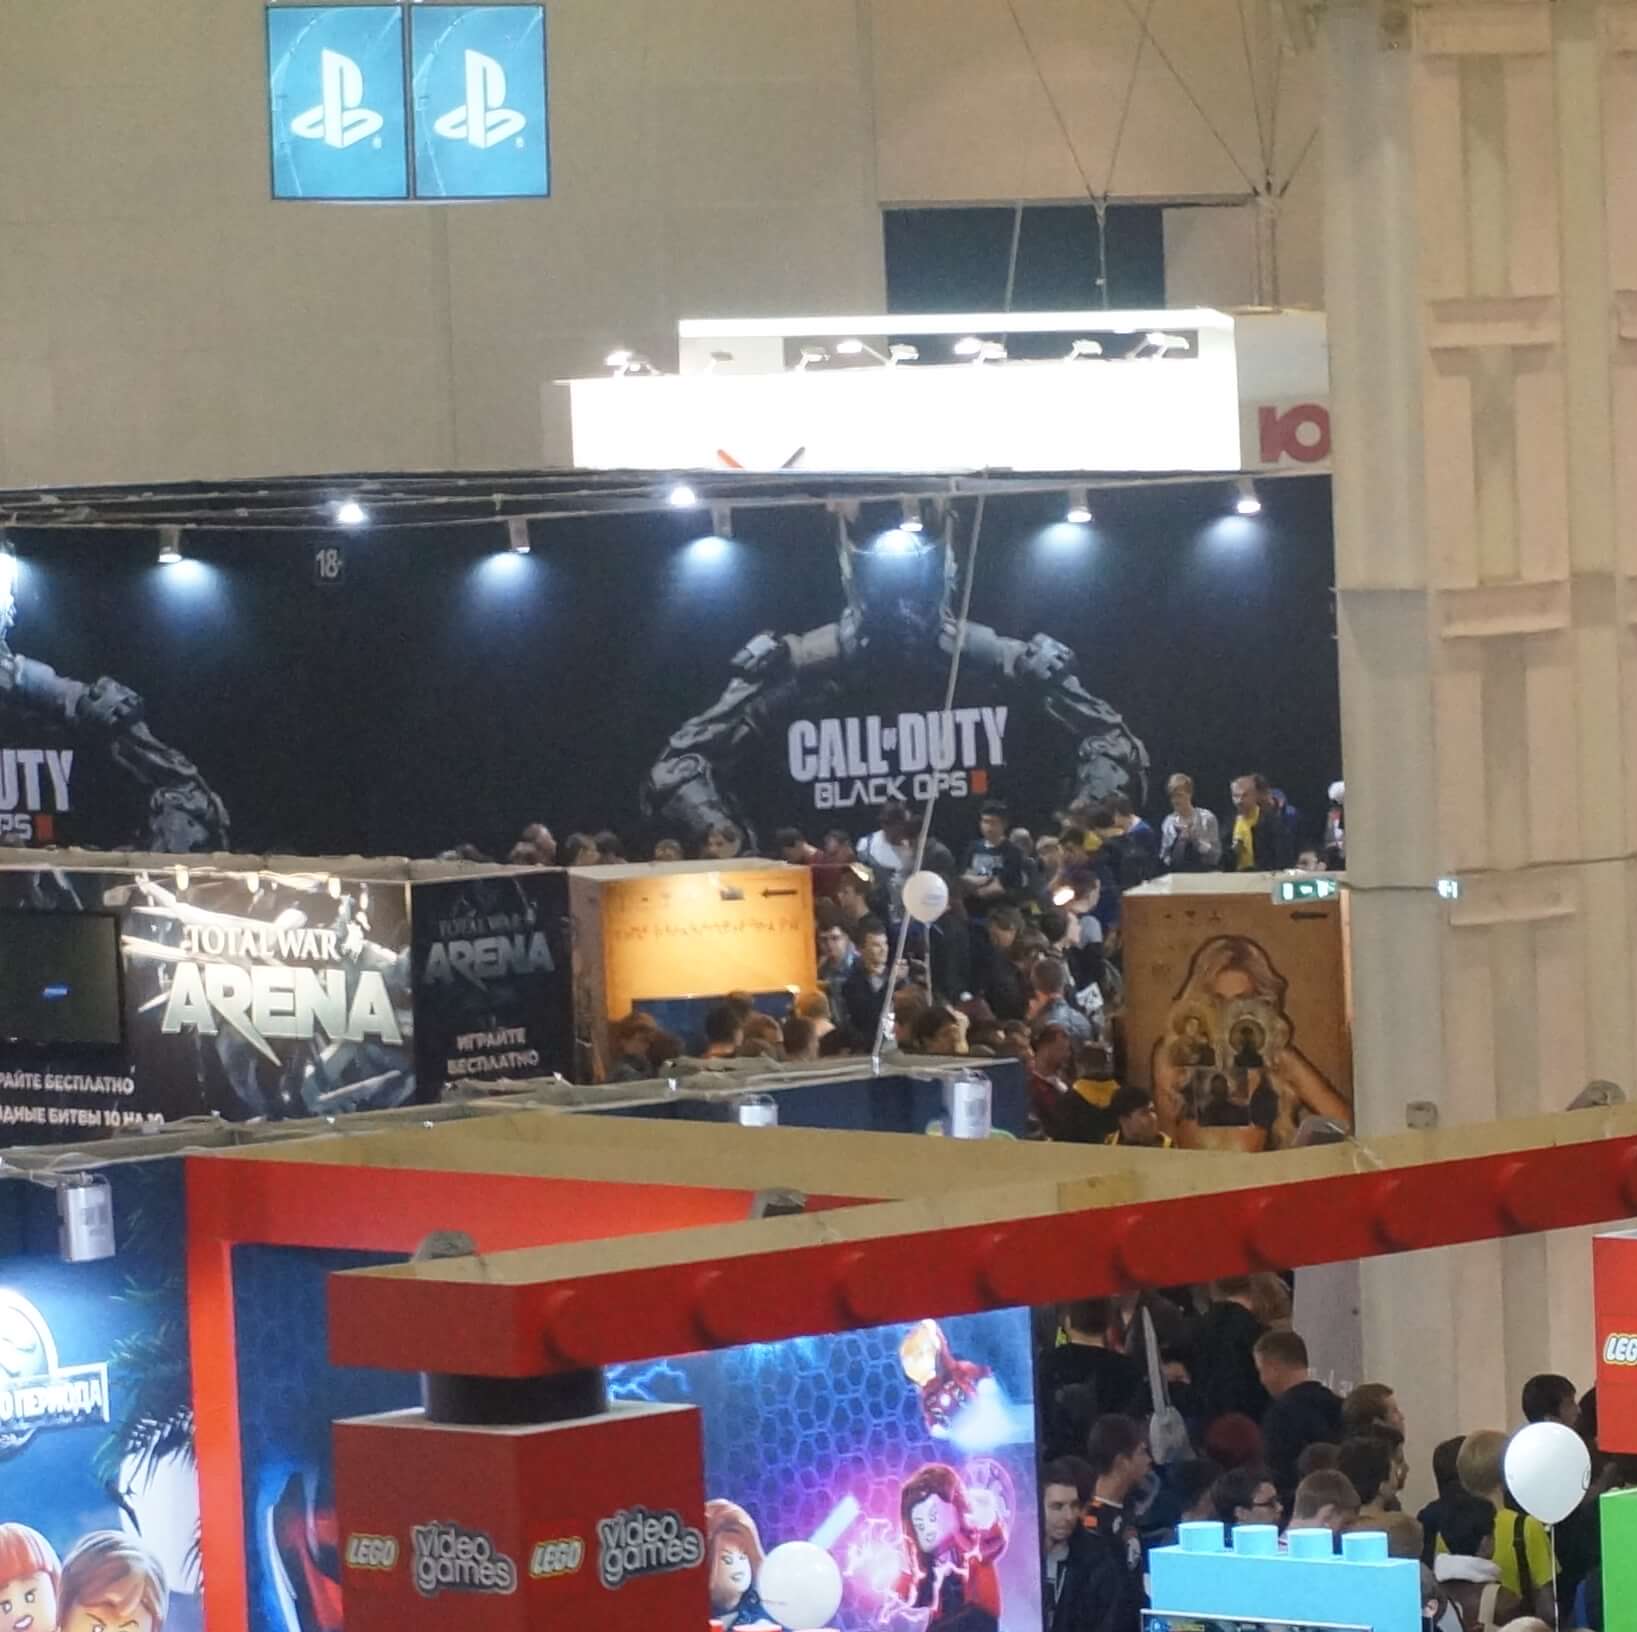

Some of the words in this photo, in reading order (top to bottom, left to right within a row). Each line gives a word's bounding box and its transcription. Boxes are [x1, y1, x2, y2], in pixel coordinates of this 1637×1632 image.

[788, 716, 890, 783] CALL
[898, 706, 1008, 772] DUTY
[814, 773, 907, 809] BLACK
[913, 769, 968, 800] OPS
[184, 924, 274, 957] TOTAL
[274, 926, 341, 962] WAR
[423, 930, 556, 992] ARENA
[161, 961, 404, 1067] ARENA
[447, 1048, 541, 1075] БЕСПЛАТНО
[44, 1073, 135, 1096] БЕСПЛАТНО
[49, 1107, 102, 1127] БИТВЫ
[415, 1524, 491, 1560] video
[602, 1512, 678, 1549] video
[350, 1537, 396, 1566] LEGO
[418, 1555, 513, 1591] games
[534, 1539, 582, 1575] LEGO
[604, 1531, 699, 1582] games
